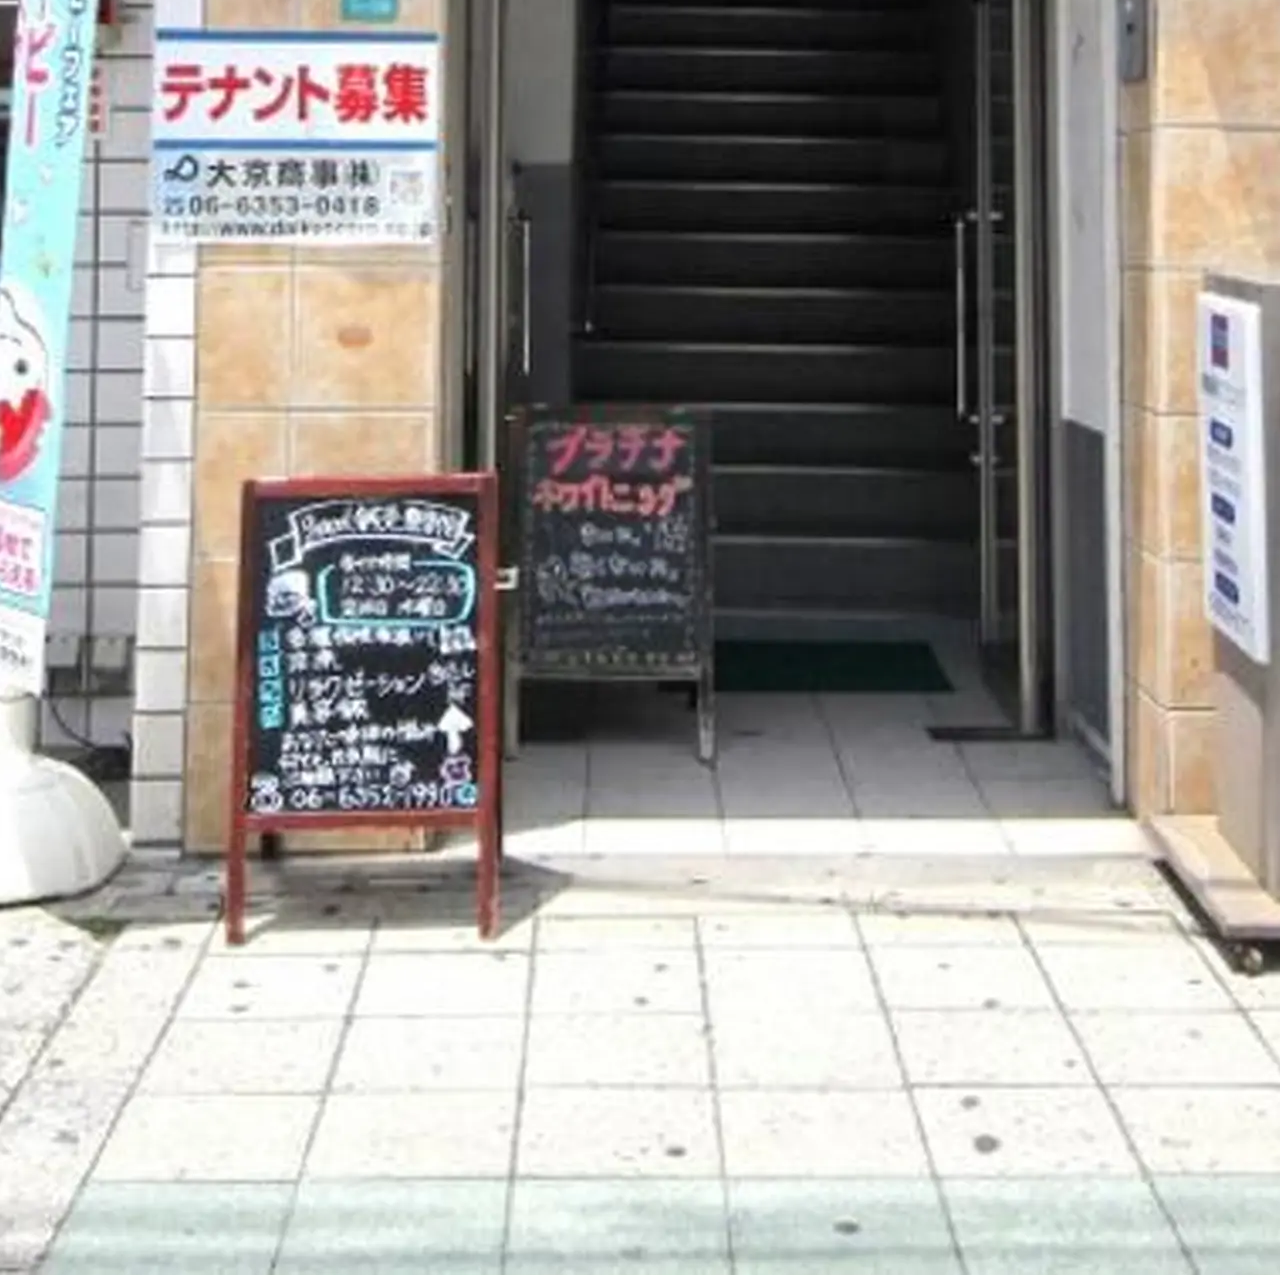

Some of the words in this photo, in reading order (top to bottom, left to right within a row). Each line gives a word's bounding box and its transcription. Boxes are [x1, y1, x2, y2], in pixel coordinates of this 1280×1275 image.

[161, 64, 429, 122] テナント募集
